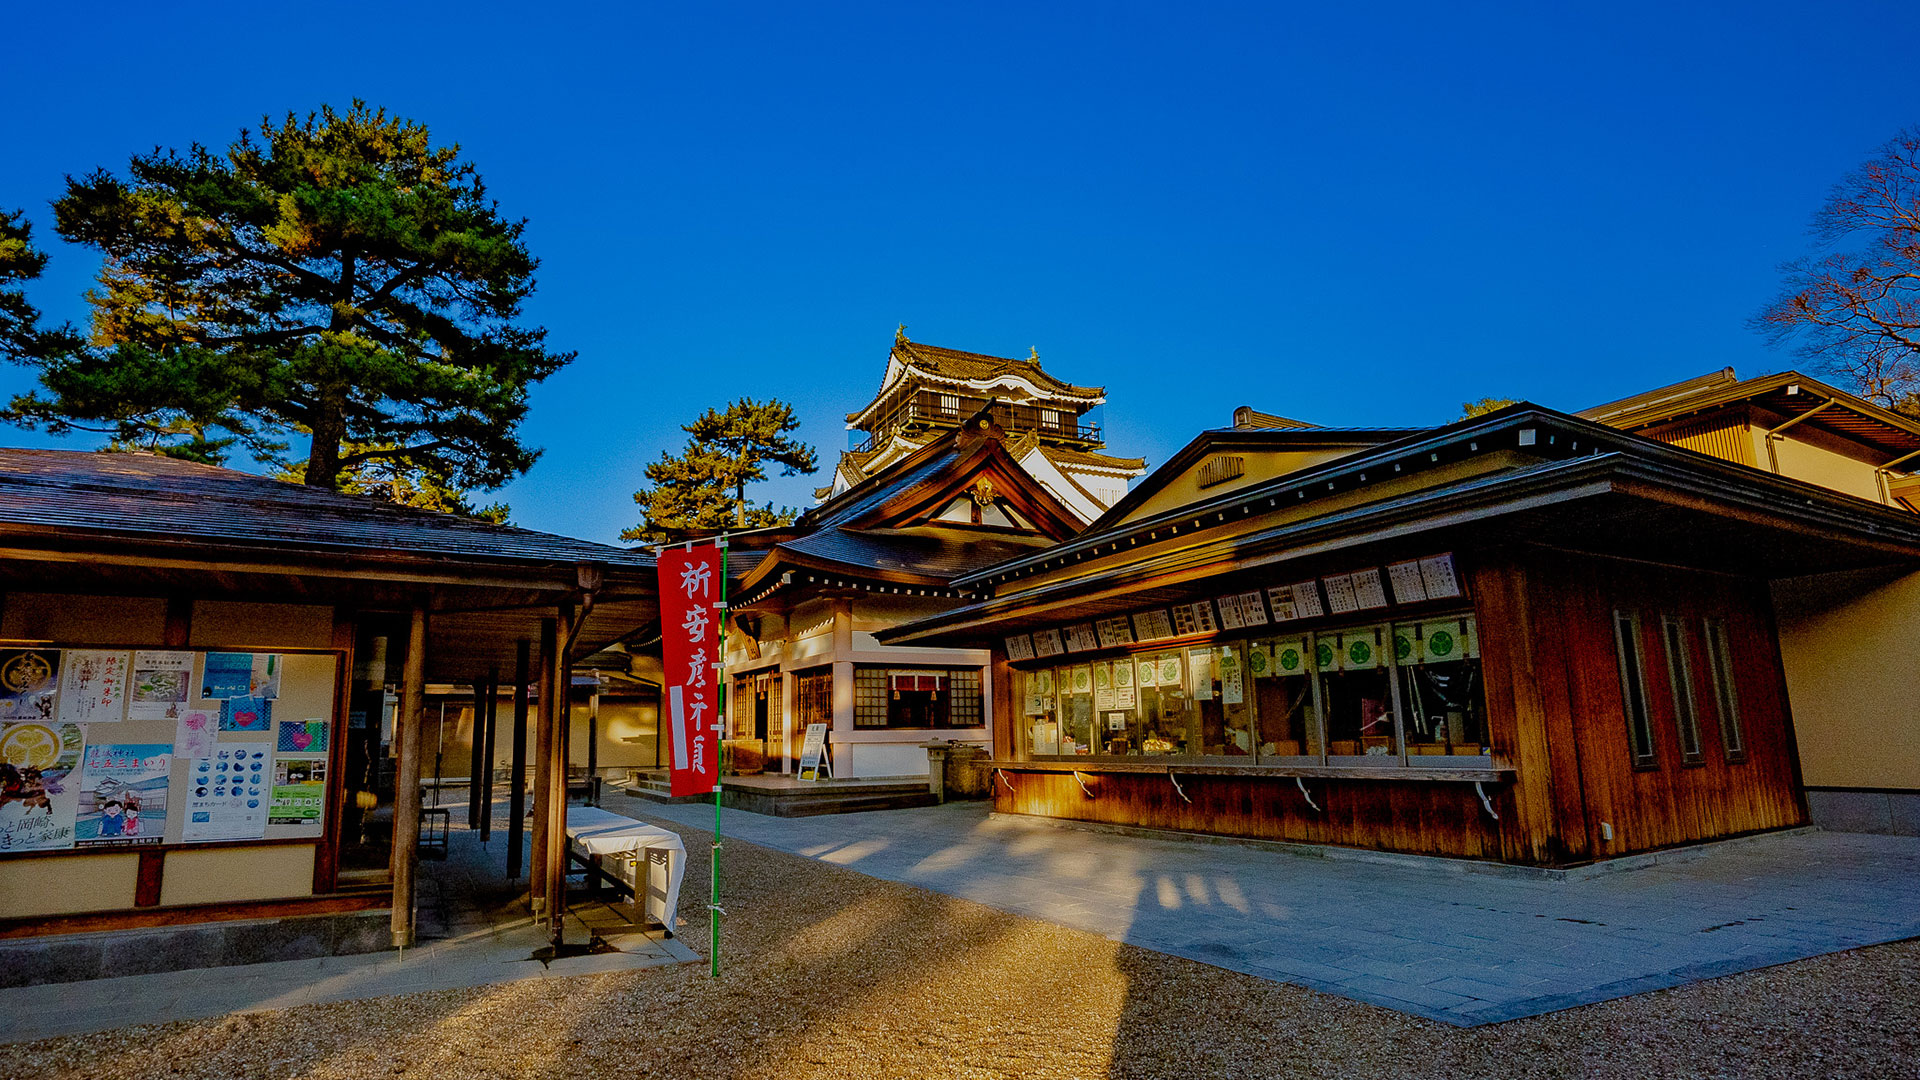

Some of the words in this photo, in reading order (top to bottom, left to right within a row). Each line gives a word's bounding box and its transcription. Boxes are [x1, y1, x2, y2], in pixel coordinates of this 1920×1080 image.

[88, 758, 166, 769] 七五三まいり
[1, 826, 71, 849] きっと家康
